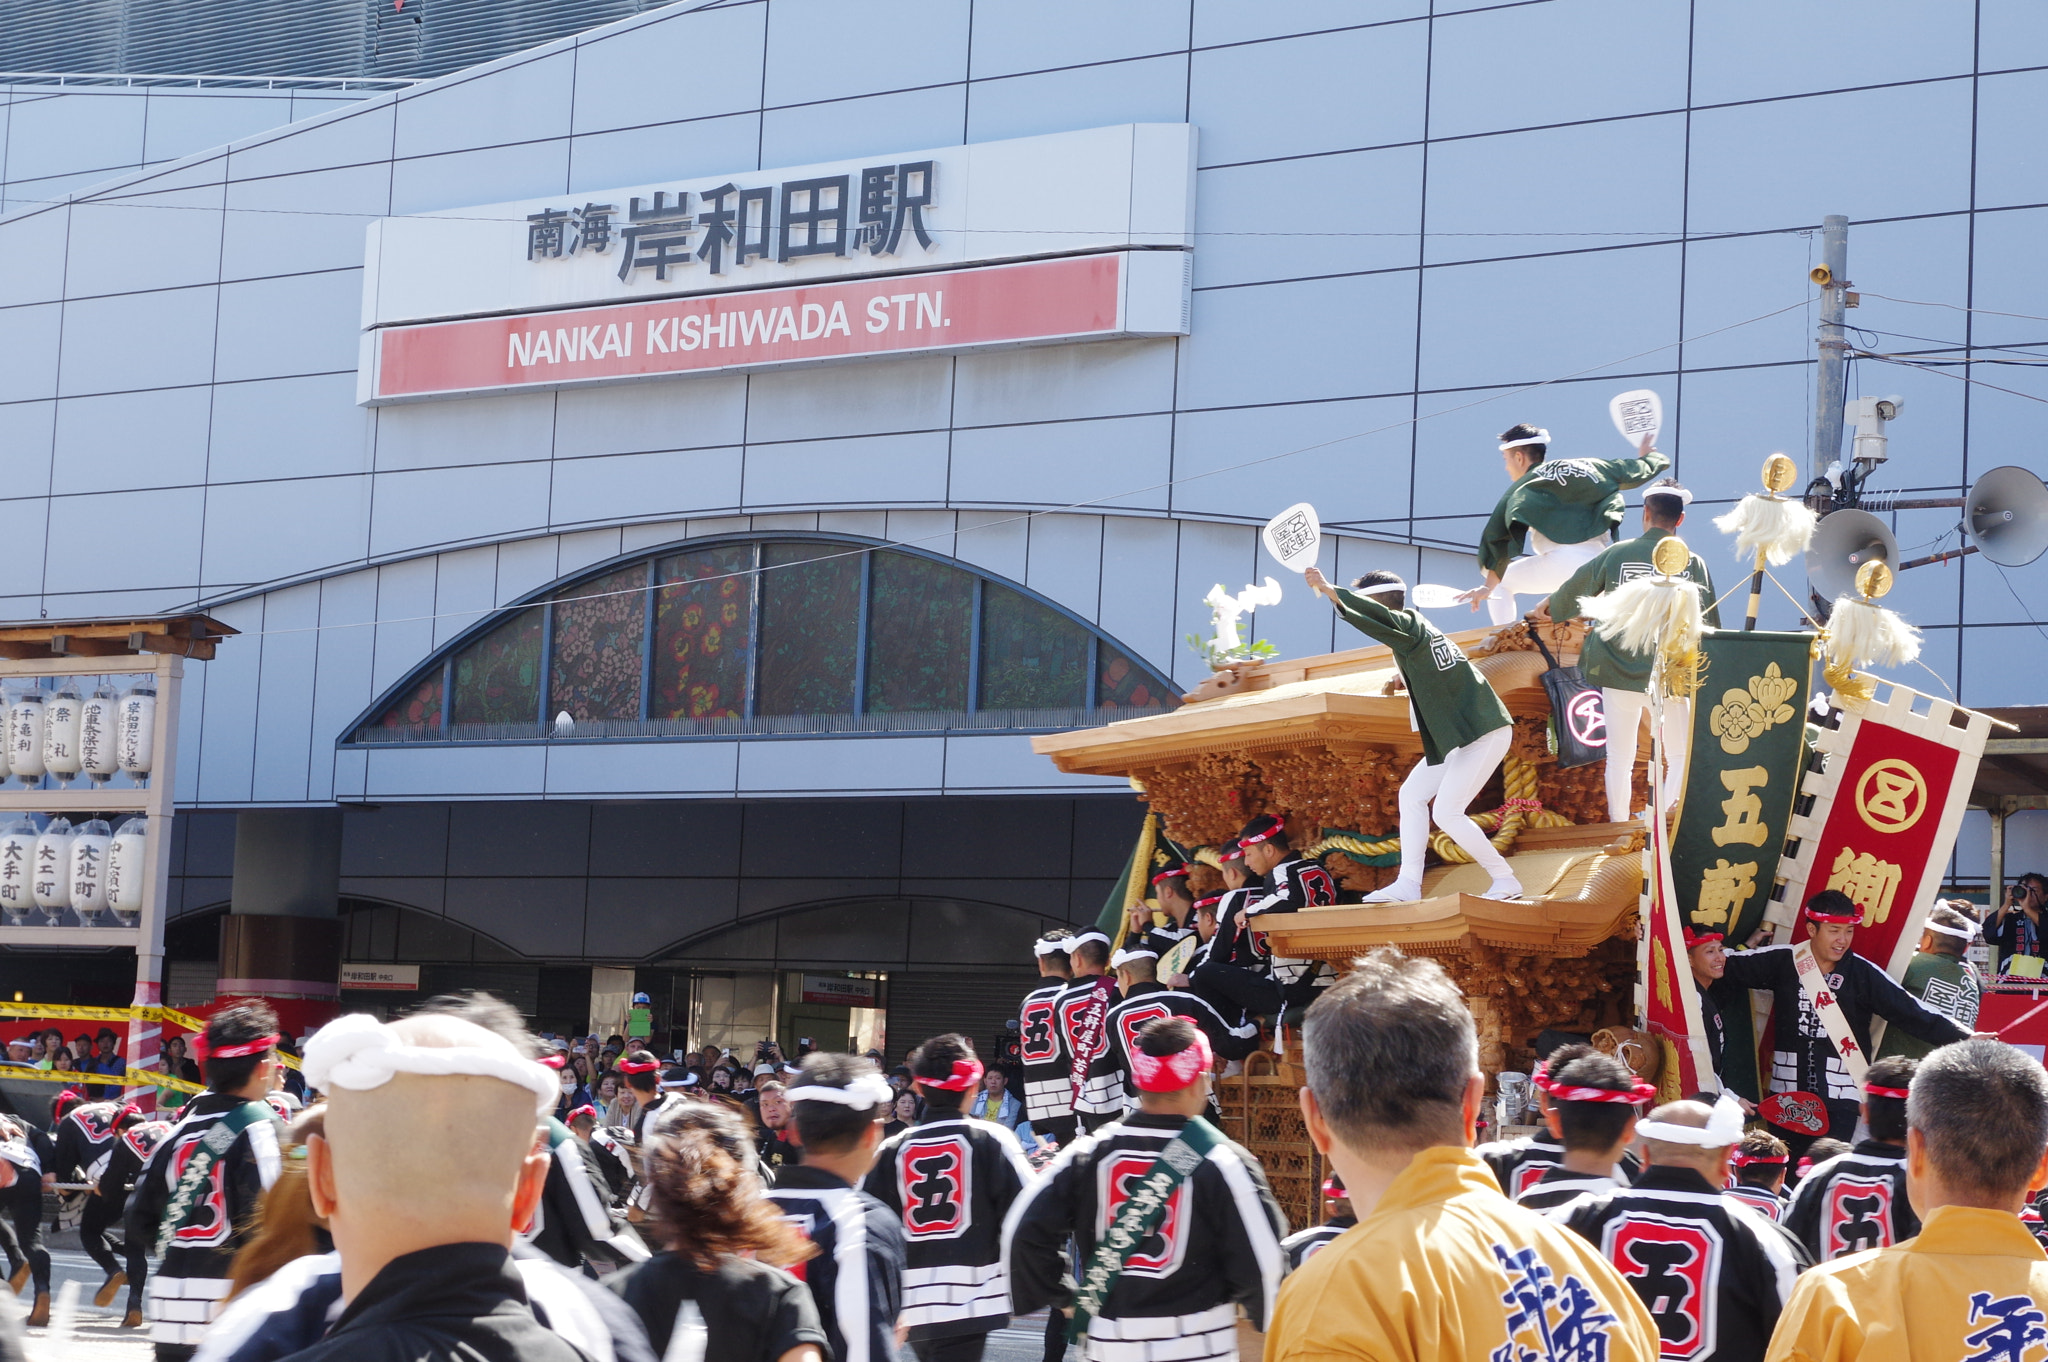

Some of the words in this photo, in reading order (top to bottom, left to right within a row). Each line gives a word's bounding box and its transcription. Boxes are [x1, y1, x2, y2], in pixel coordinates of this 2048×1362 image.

[508, 322, 632, 367] NANKAI
[646, 301, 851, 354] KISHIWADA
[866, 290, 950, 334] STN.
[17, 709, 34, 752] 千亀利
[2, 840, 23, 901] 大手町
[36, 845, 56, 897] 大工町
[75, 844, 100, 899] 大北町
[1691, 765, 1769, 936] 五軒
[1024, 1008, 1051, 1055] 五
[909, 1153, 959, 1226] 五
[1624, 1238, 1699, 1345] 五
[1958, 1291, 2048, 1362] 年
